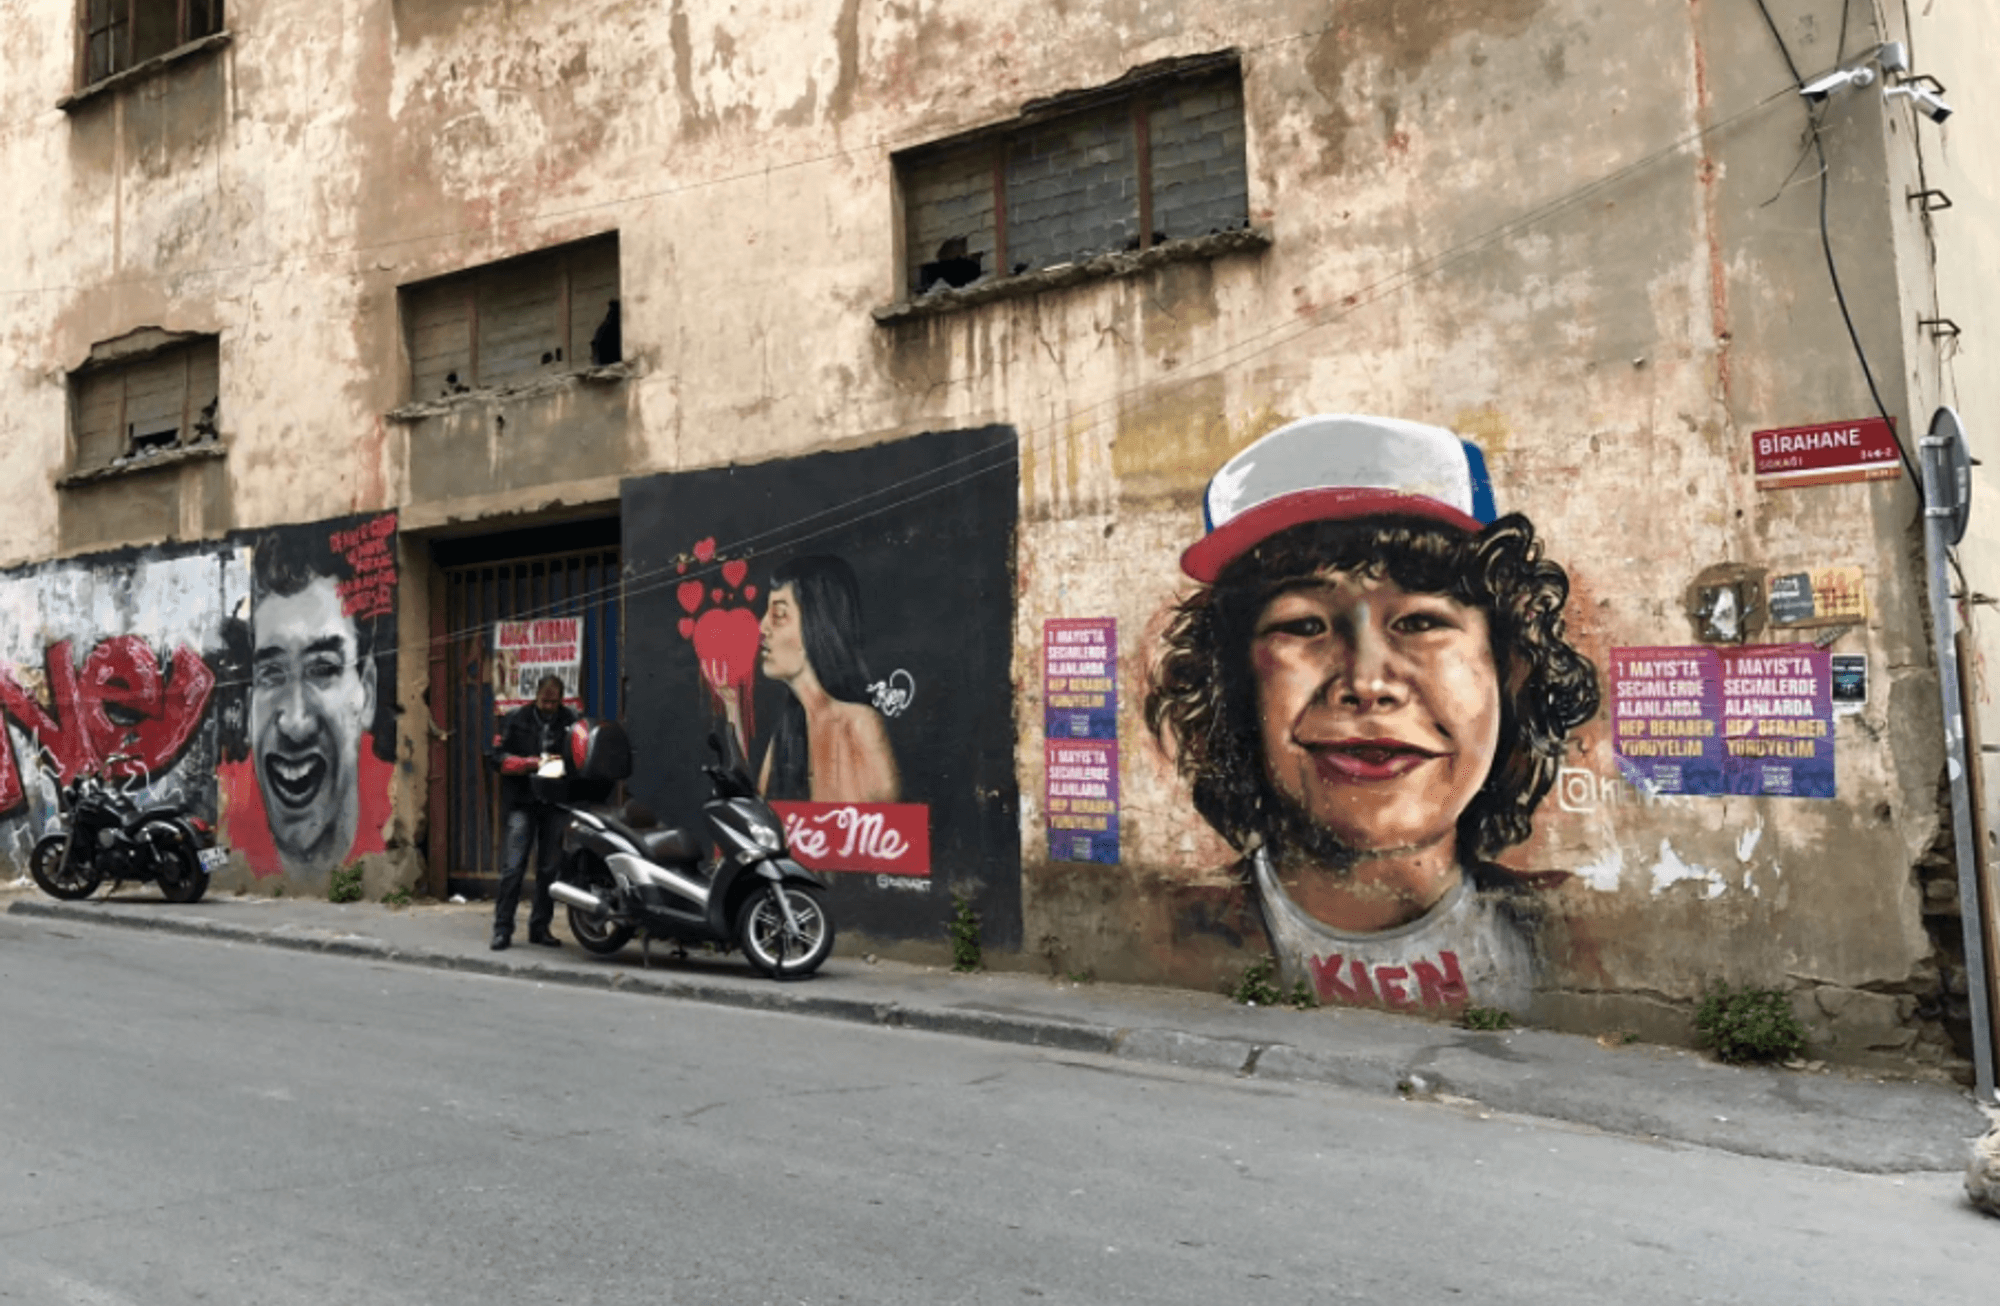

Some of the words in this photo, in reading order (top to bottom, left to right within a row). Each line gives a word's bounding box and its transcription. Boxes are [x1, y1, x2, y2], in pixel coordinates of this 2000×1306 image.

[1758, 427, 1861, 455] BİRAHANE
[1617, 661, 1623, 677] 1
[1629, 660, 1700, 677] MAYIS'TA
[1725, 658, 1732, 675] 1
[1738, 657, 1813, 676] MAYIS'TA
[1617, 700, 1702, 717] ALANLARDA
[1724, 699, 1814, 716] ALANLARDA
[1619, 719, 1646, 736] HEP
[1650, 719, 1715, 737] BERABER
[785, 813, 829, 858] ike
[812, 805, 909, 859] Me
[1309, 950, 1470, 1010] KIEN
